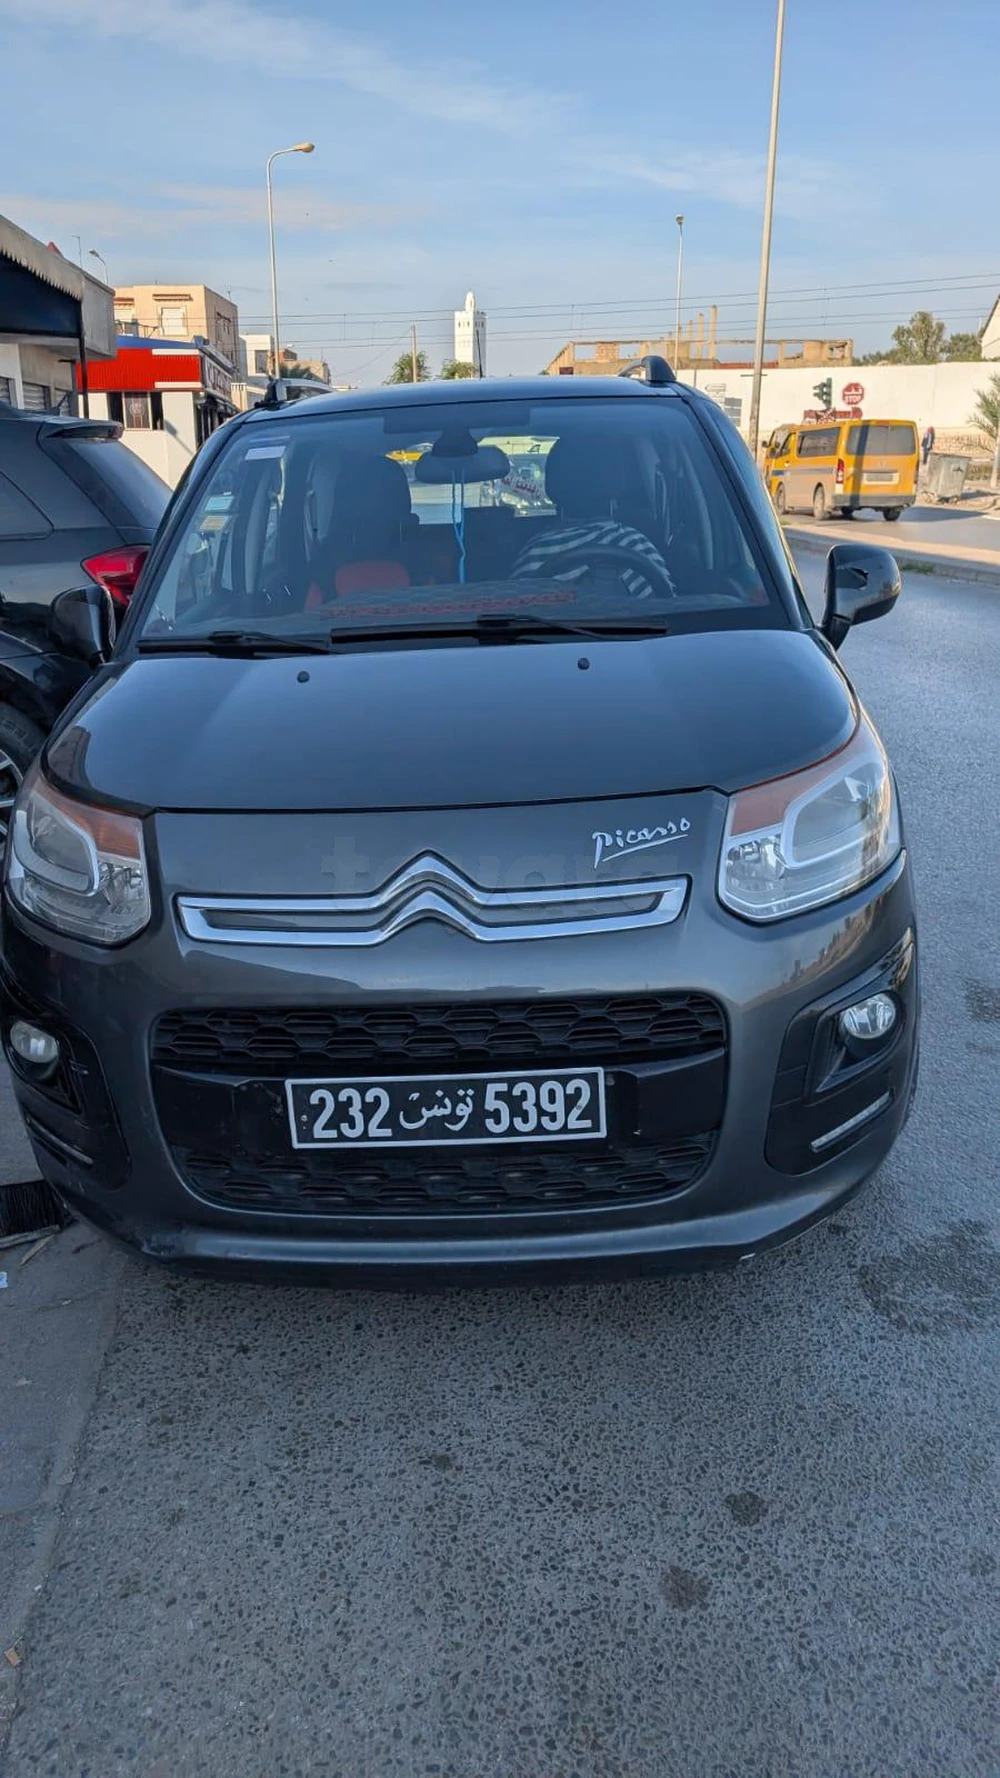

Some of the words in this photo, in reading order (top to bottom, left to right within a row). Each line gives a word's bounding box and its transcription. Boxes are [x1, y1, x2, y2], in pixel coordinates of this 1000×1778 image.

[844, 395, 862, 403] STOP
[309, 1087, 393, 1139] 232
[399, 1089, 474, 1131] تونس
[484, 1078, 593, 1133] 5392
